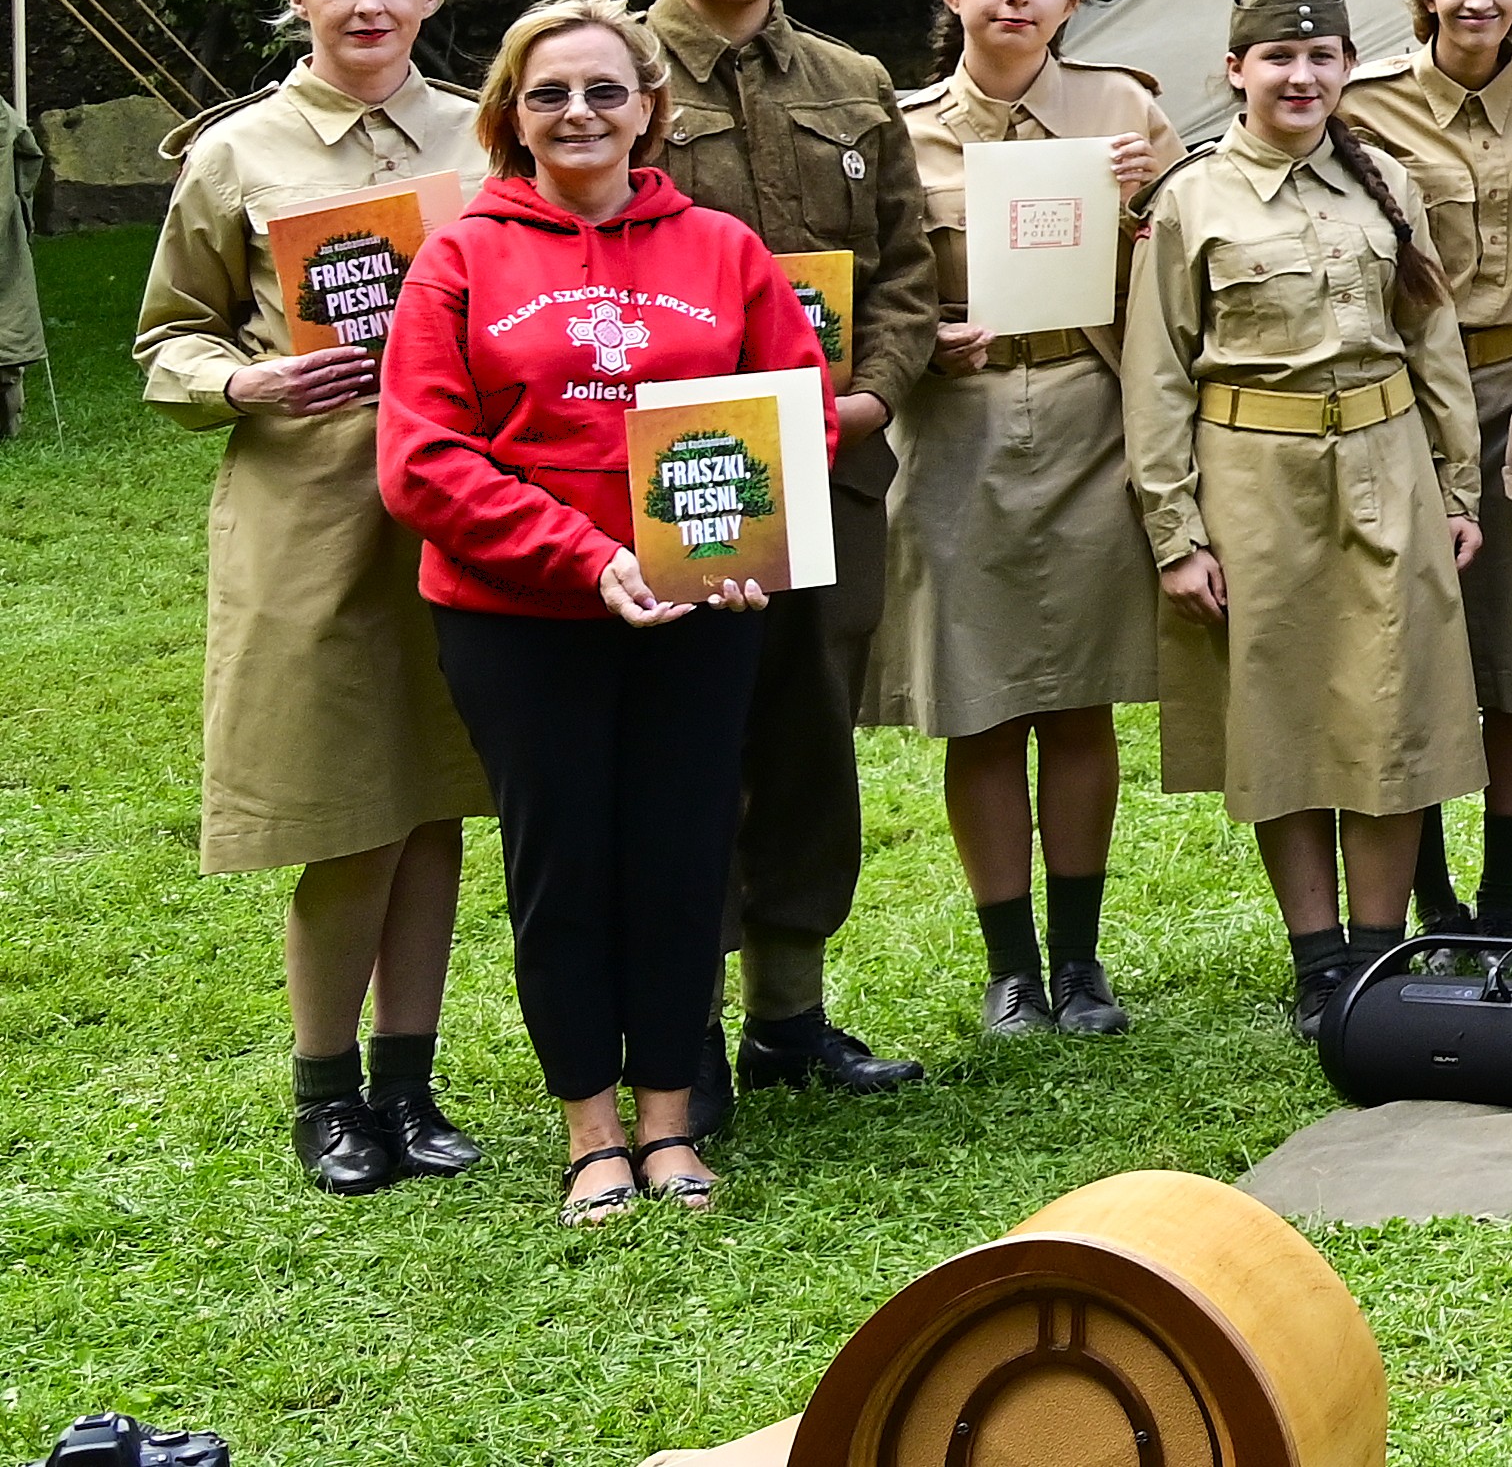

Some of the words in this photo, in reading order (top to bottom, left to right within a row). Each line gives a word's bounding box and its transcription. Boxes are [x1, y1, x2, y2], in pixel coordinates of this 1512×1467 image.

[487, 294, 554, 337] POLSKA
[553, 285, 618, 304] SZKOŁA
[655, 293, 718, 328] KRZYŻA
[561, 381, 633, 402] Joliet,
[678, 514, 742, 546] TRENY
